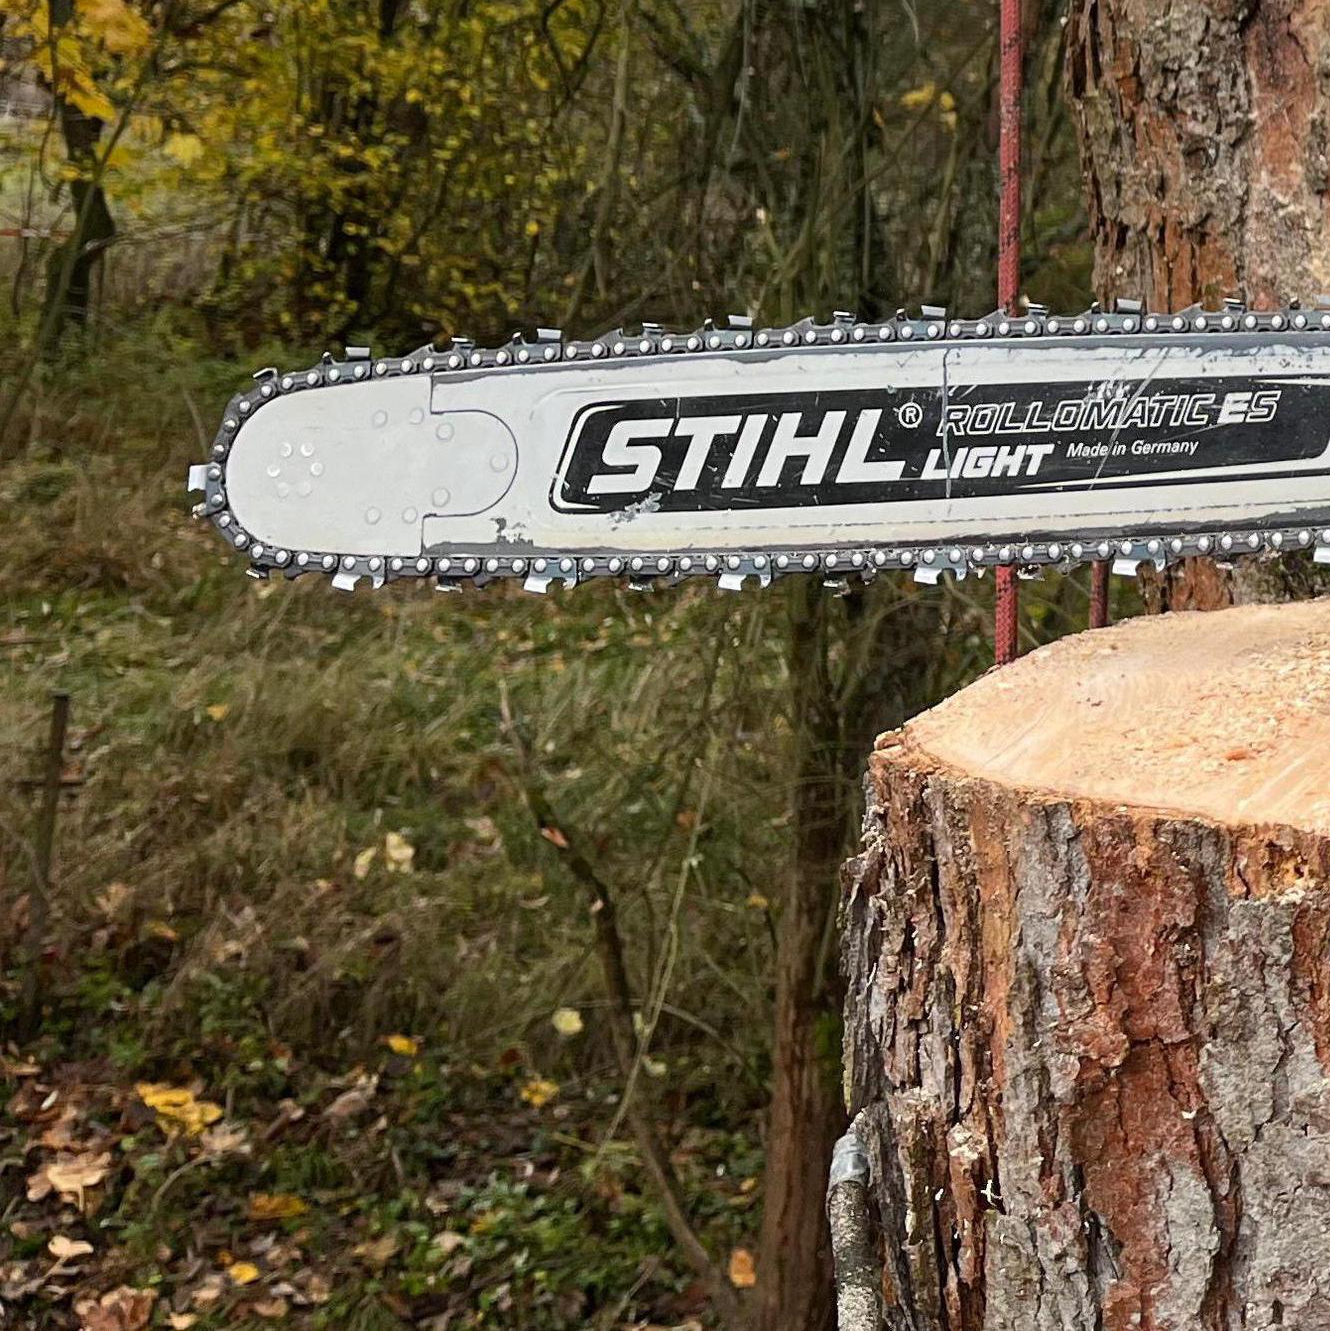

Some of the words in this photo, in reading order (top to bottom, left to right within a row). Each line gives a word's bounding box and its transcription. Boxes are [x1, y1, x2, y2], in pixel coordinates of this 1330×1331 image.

[936, 394, 1211, 436] ROLLOMATIC
[1216, 390, 1281, 425] ES
[920, 444, 1054, 480] LIGHT
[1066, 441, 1108, 458] Made
[1112, 441, 1127, 456] in
[1131, 439, 1199, 459] Germany
